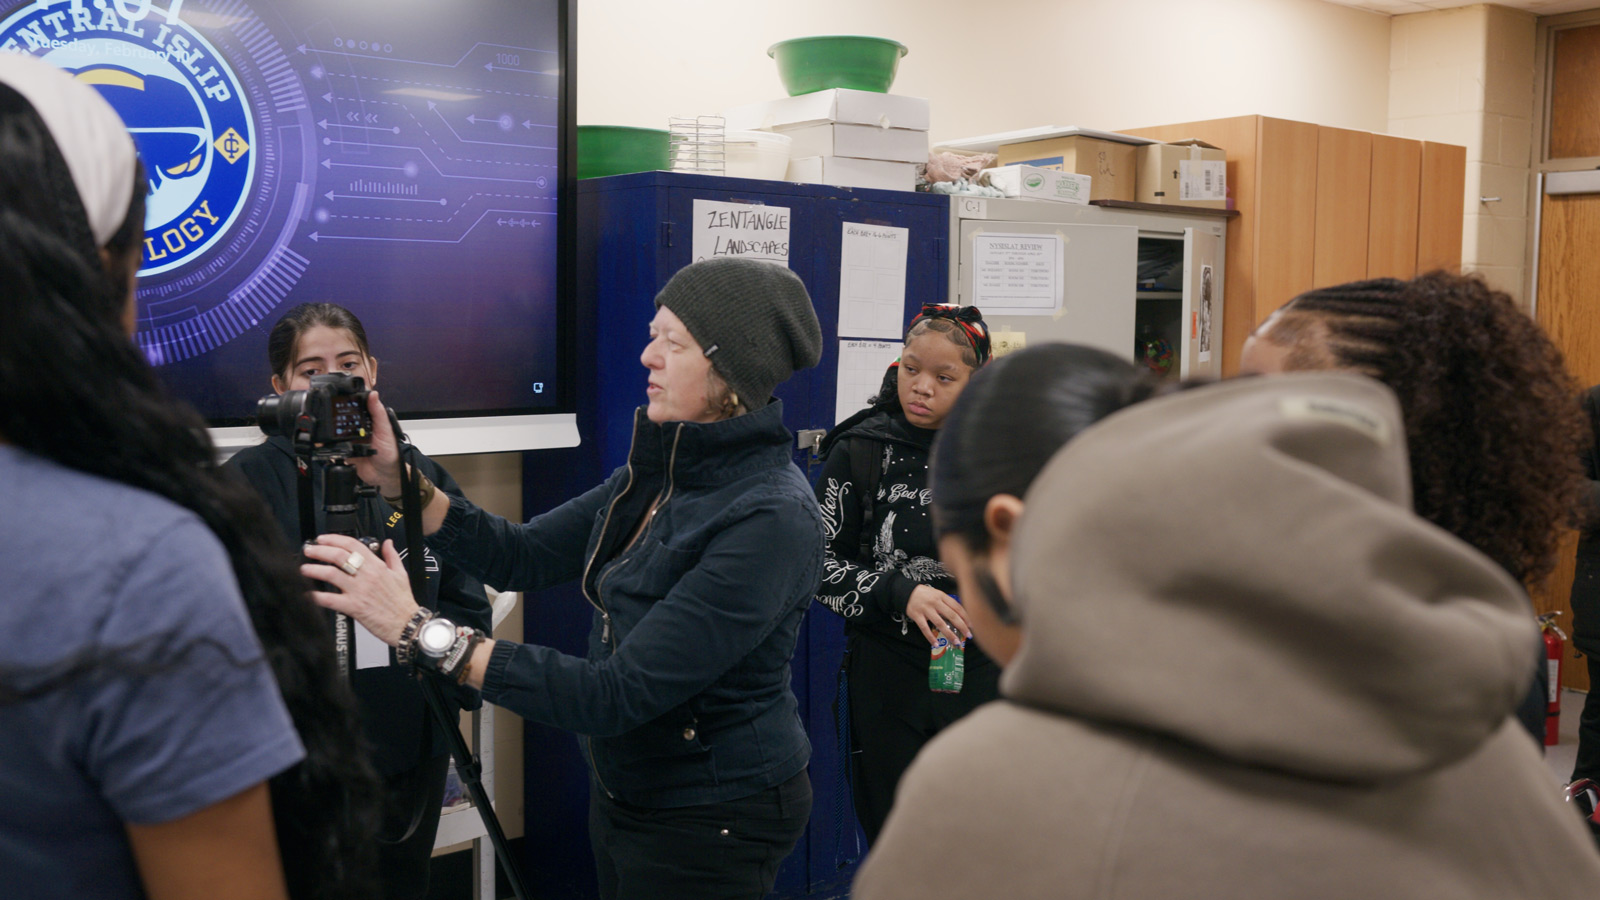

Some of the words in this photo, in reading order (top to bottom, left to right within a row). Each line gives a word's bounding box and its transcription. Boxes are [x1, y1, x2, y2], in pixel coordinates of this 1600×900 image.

[2, 5, 146, 58] ENTRAL
[152, 23, 232, 103] ISLIP
[104, 41, 170, 65] February
[496, 53, 520, 66] 1000
[707, 210, 788, 231] ZENTANGLE
[713, 236, 789, 257] LANDSCAPES
[1020, 243, 1043, 251] REVIEW
[887, 483, 919, 504] God
[385, 511, 404, 528] LEG
[335, 613, 348, 652] AGNUS
